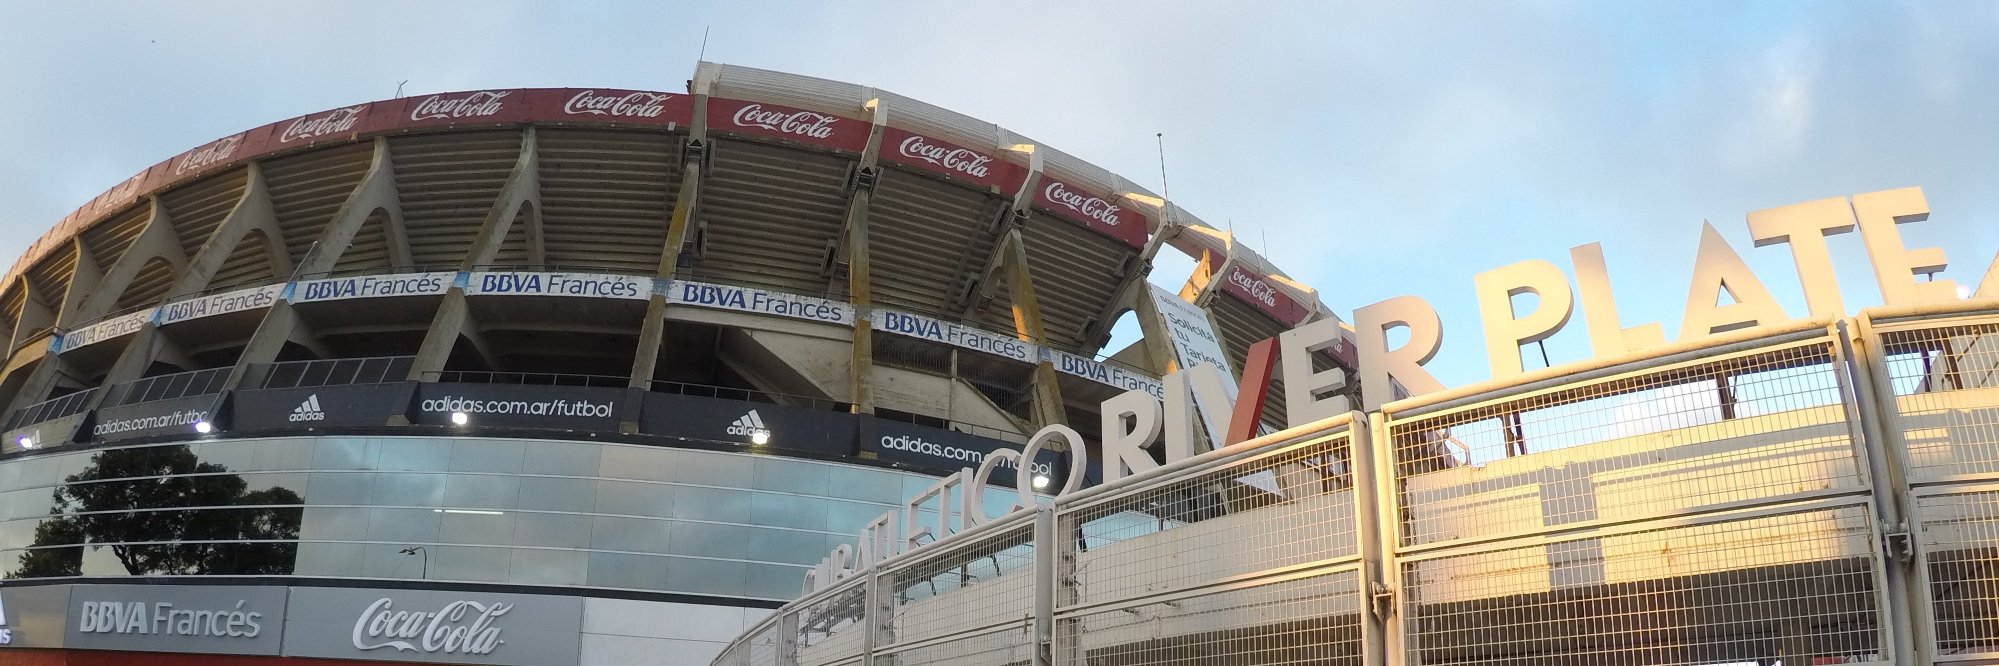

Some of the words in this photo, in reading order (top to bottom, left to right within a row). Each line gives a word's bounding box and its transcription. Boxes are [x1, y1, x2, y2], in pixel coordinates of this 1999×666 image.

[411, 91, 514, 121] Coca-Cola
[564, 90, 673, 118] Coca-Cola
[733, 104, 840, 139] Coca-Cola
[280, 105, 367, 143] Coca-Cola
[900, 136, 994, 178] Coca-Cola
[1045, 182, 1121, 226] Coca-Cola
[304, 279, 357, 300] BBVA
[360, 274, 441, 297] Francés
[480, 274, 541, 293] BBVA
[547, 275, 638, 297] Francés
[683, 284, 747, 309] BBVA
[751, 292, 843, 322] Francés
[168, 299, 207, 322] BBVA
[208, 287, 273, 314] Francés
[884, 312, 943, 340] BBVA
[946, 324, 1026, 359] Francés
[1100, 295, 1448, 486] RIVER
[1474, 186, 1956, 382] PLATE
[1174, 328, 1191, 343] tu
[1061, 353, 1110, 383] BBVA
[1112, 369, 1164, 399] Francé
[289, 411, 325, 422] adidas
[421, 396, 614, 418] adidas.com.ar/futbol
[79, 601, 148, 634] BBVA
[152, 599, 261, 639] Francés
[352, 597, 515, 655] Coca-Cola
